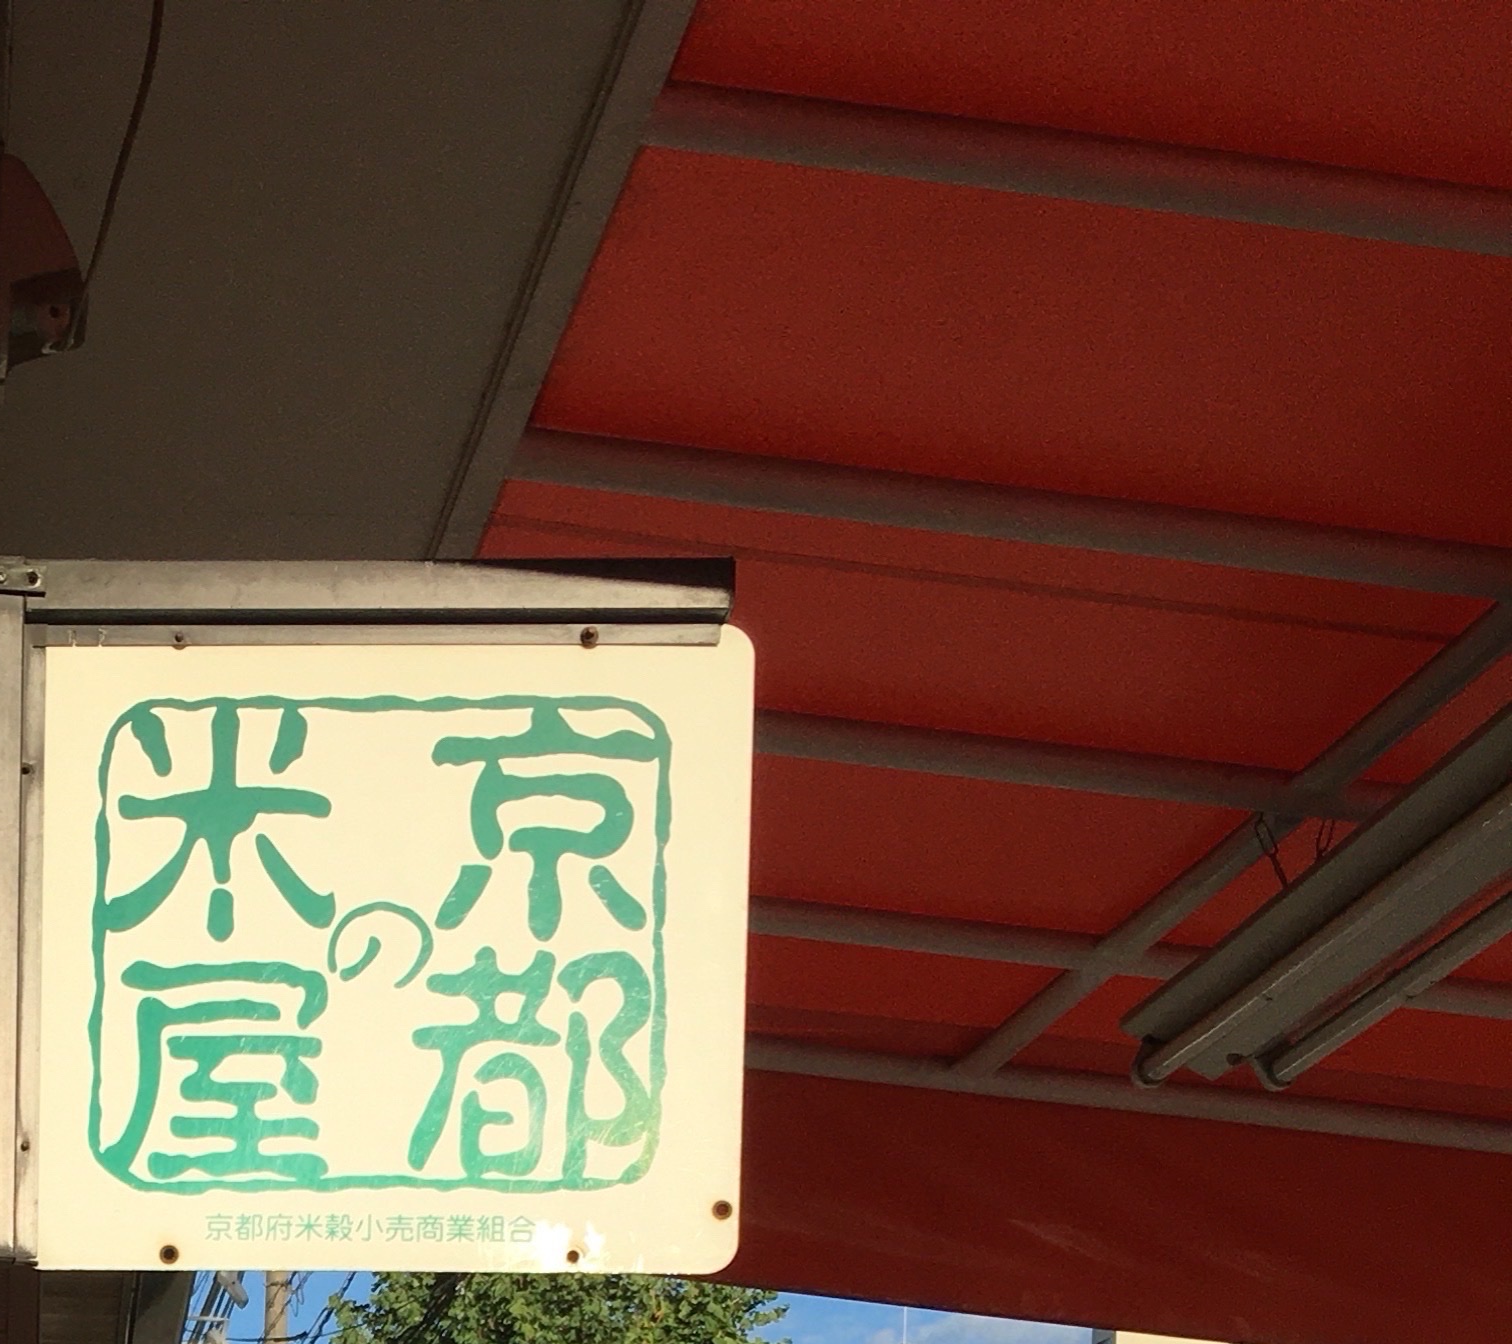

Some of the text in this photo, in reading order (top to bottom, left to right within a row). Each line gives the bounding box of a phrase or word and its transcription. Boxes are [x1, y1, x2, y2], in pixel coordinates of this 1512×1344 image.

[104, 706, 336, 1180] 米屋
[328, 901, 433, 988] の
[408, 704, 665, 1180] 京都
[204, 1213, 536, 1244] 京都府米穀小売商業組合
